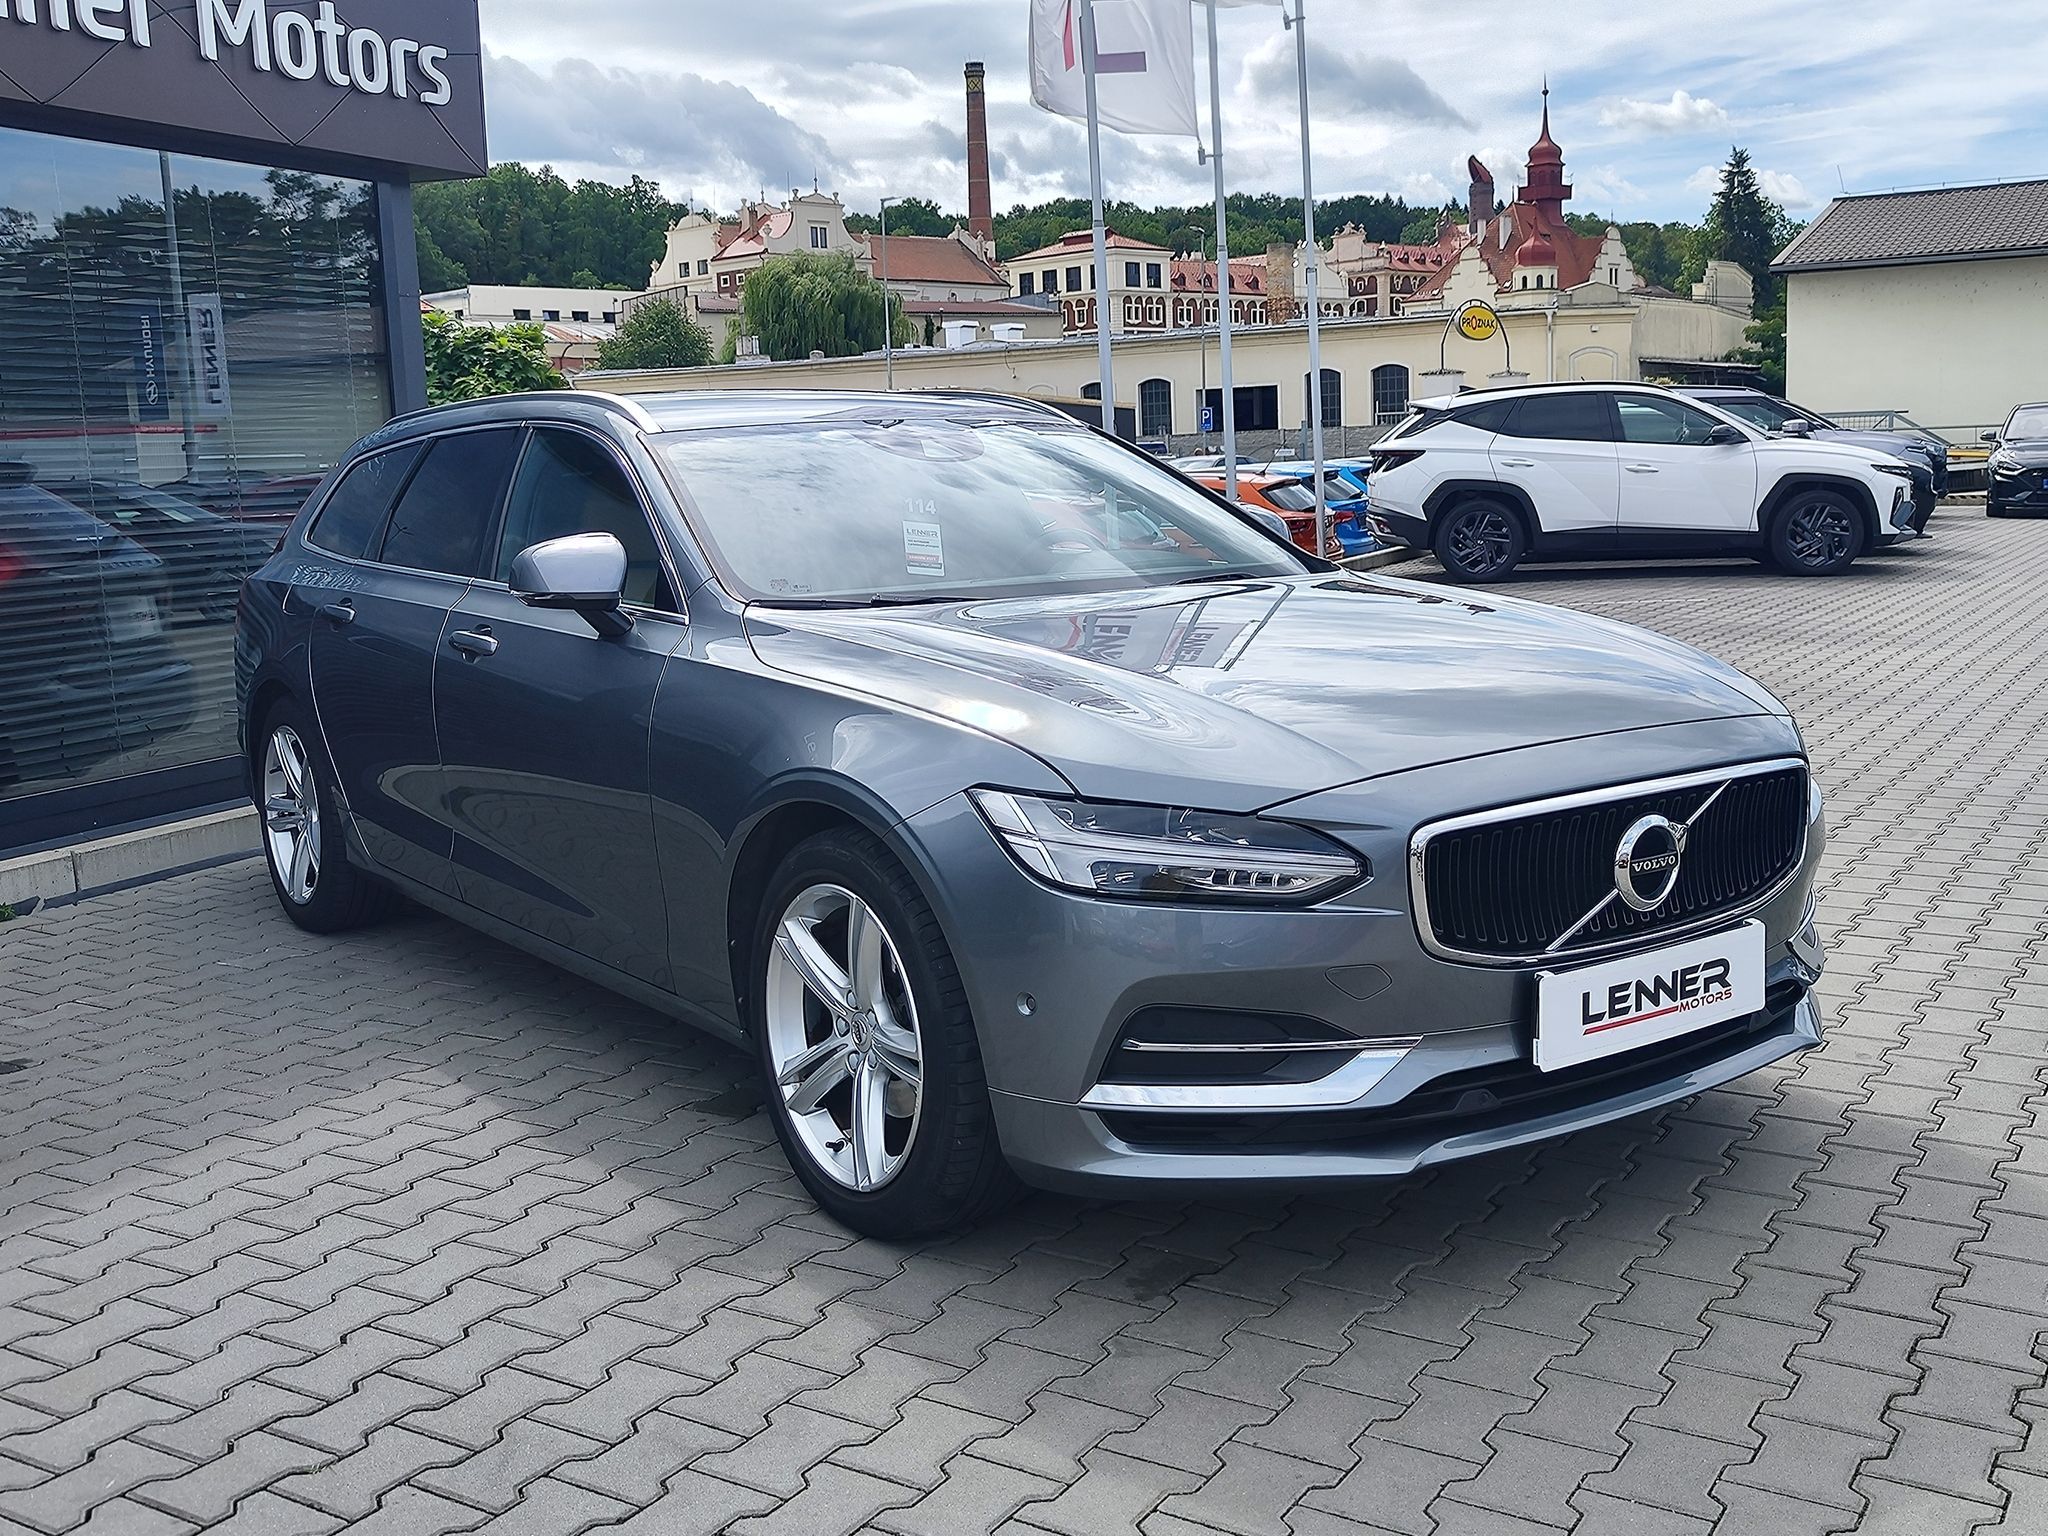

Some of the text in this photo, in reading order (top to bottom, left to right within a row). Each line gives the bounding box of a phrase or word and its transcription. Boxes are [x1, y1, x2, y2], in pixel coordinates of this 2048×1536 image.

[196, 0, 452, 106] Motors
[1461, 315, 1495, 330] PROZNAK
[1202, 410, 1210, 424] P
[904, 498, 937, 515] 114
[1632, 855, 1676, 872] VOLVO
[1582, 958, 1733, 1026] LENNER
[1679, 988, 1733, 1013] MOTORS
